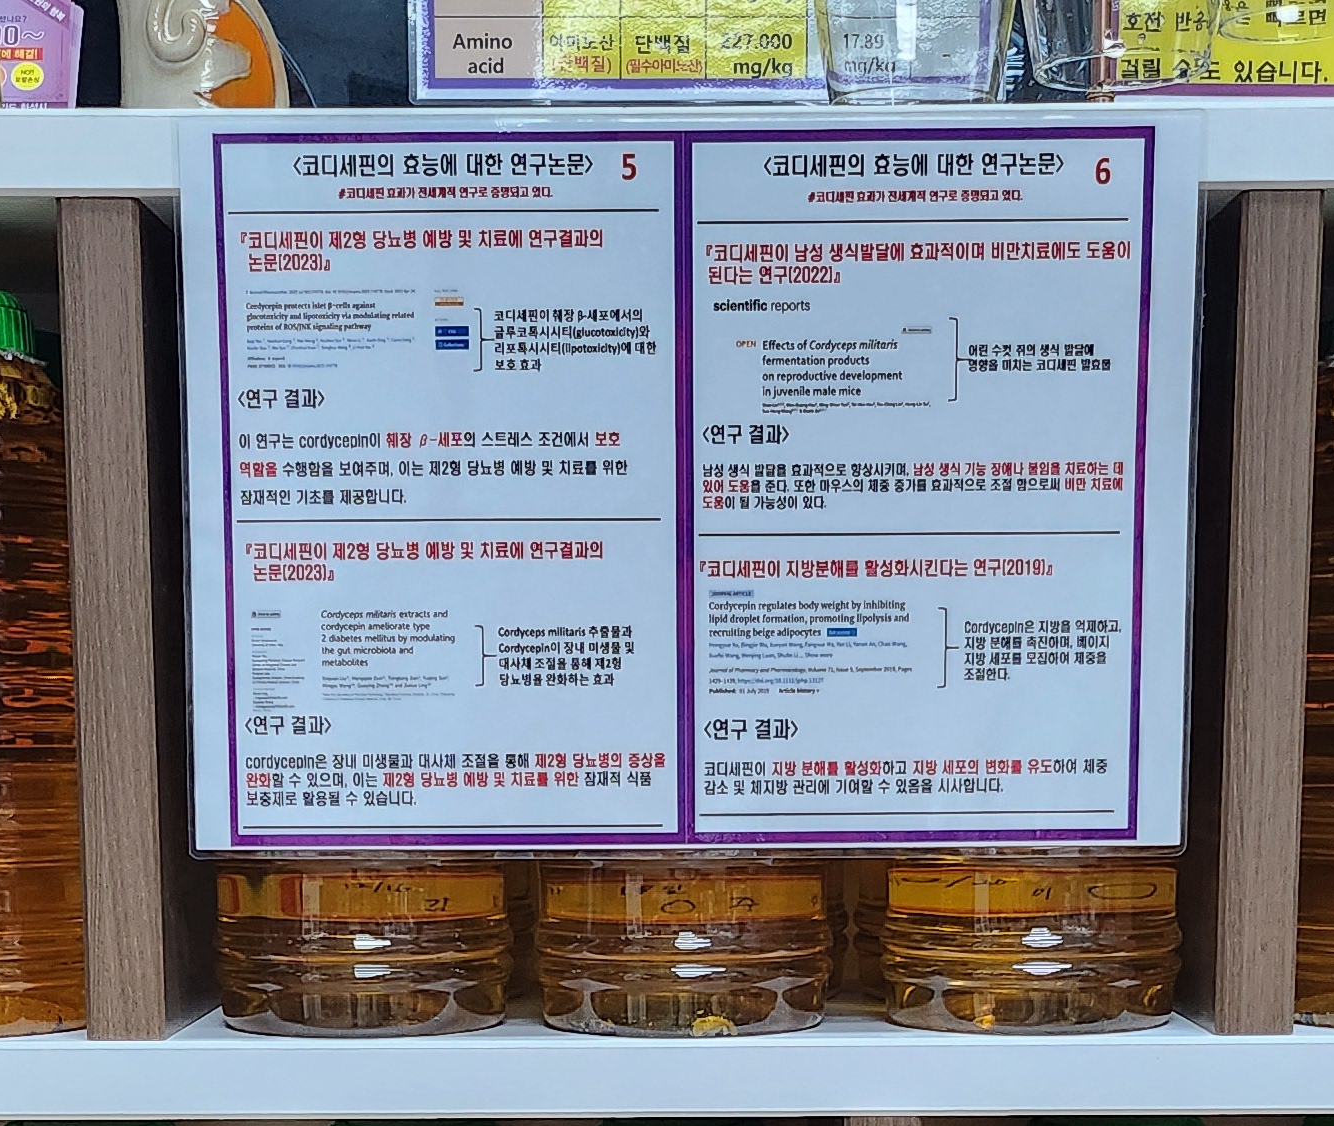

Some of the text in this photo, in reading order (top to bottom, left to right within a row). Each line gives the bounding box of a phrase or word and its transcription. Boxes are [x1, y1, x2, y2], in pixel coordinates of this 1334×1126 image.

[453, 32, 513, 50] Amino
[635, 32, 691, 54] 단백질
[467, 57, 505, 76] acid
[733, 58, 794, 79] mg/kg
[1234, 60, 1329, 84] 있습니다.
[402, 153, 458, 177] 효능에
[466, 152, 504, 177] 대한
[621, 153, 637, 180] 5
[873, 153, 928, 178] 효능에
[937, 152, 975, 177] 대한
[1094, 156, 1112, 185] 6
[328, 230, 367, 251] 제2형
[372, 229, 417, 250] 당뇨병
[422, 229, 453, 249] 예방
[458, 229, 472, 249] 및
[477, 229, 523, 249] 치료에
[528, 228, 603, 249] 연구결과의
[713, 298, 811, 315] scientific reports
[762, 338, 899, 354] Effects of Cordyceps militaris
[761, 354, 870, 369] fermentation products
[761, 369, 903, 385] on reproductive development
[762, 385, 863, 400] in juvenile male mice
[785, 559, 859, 579] 지방분해를
[864, 558, 969, 578] 활성화시킨다는
